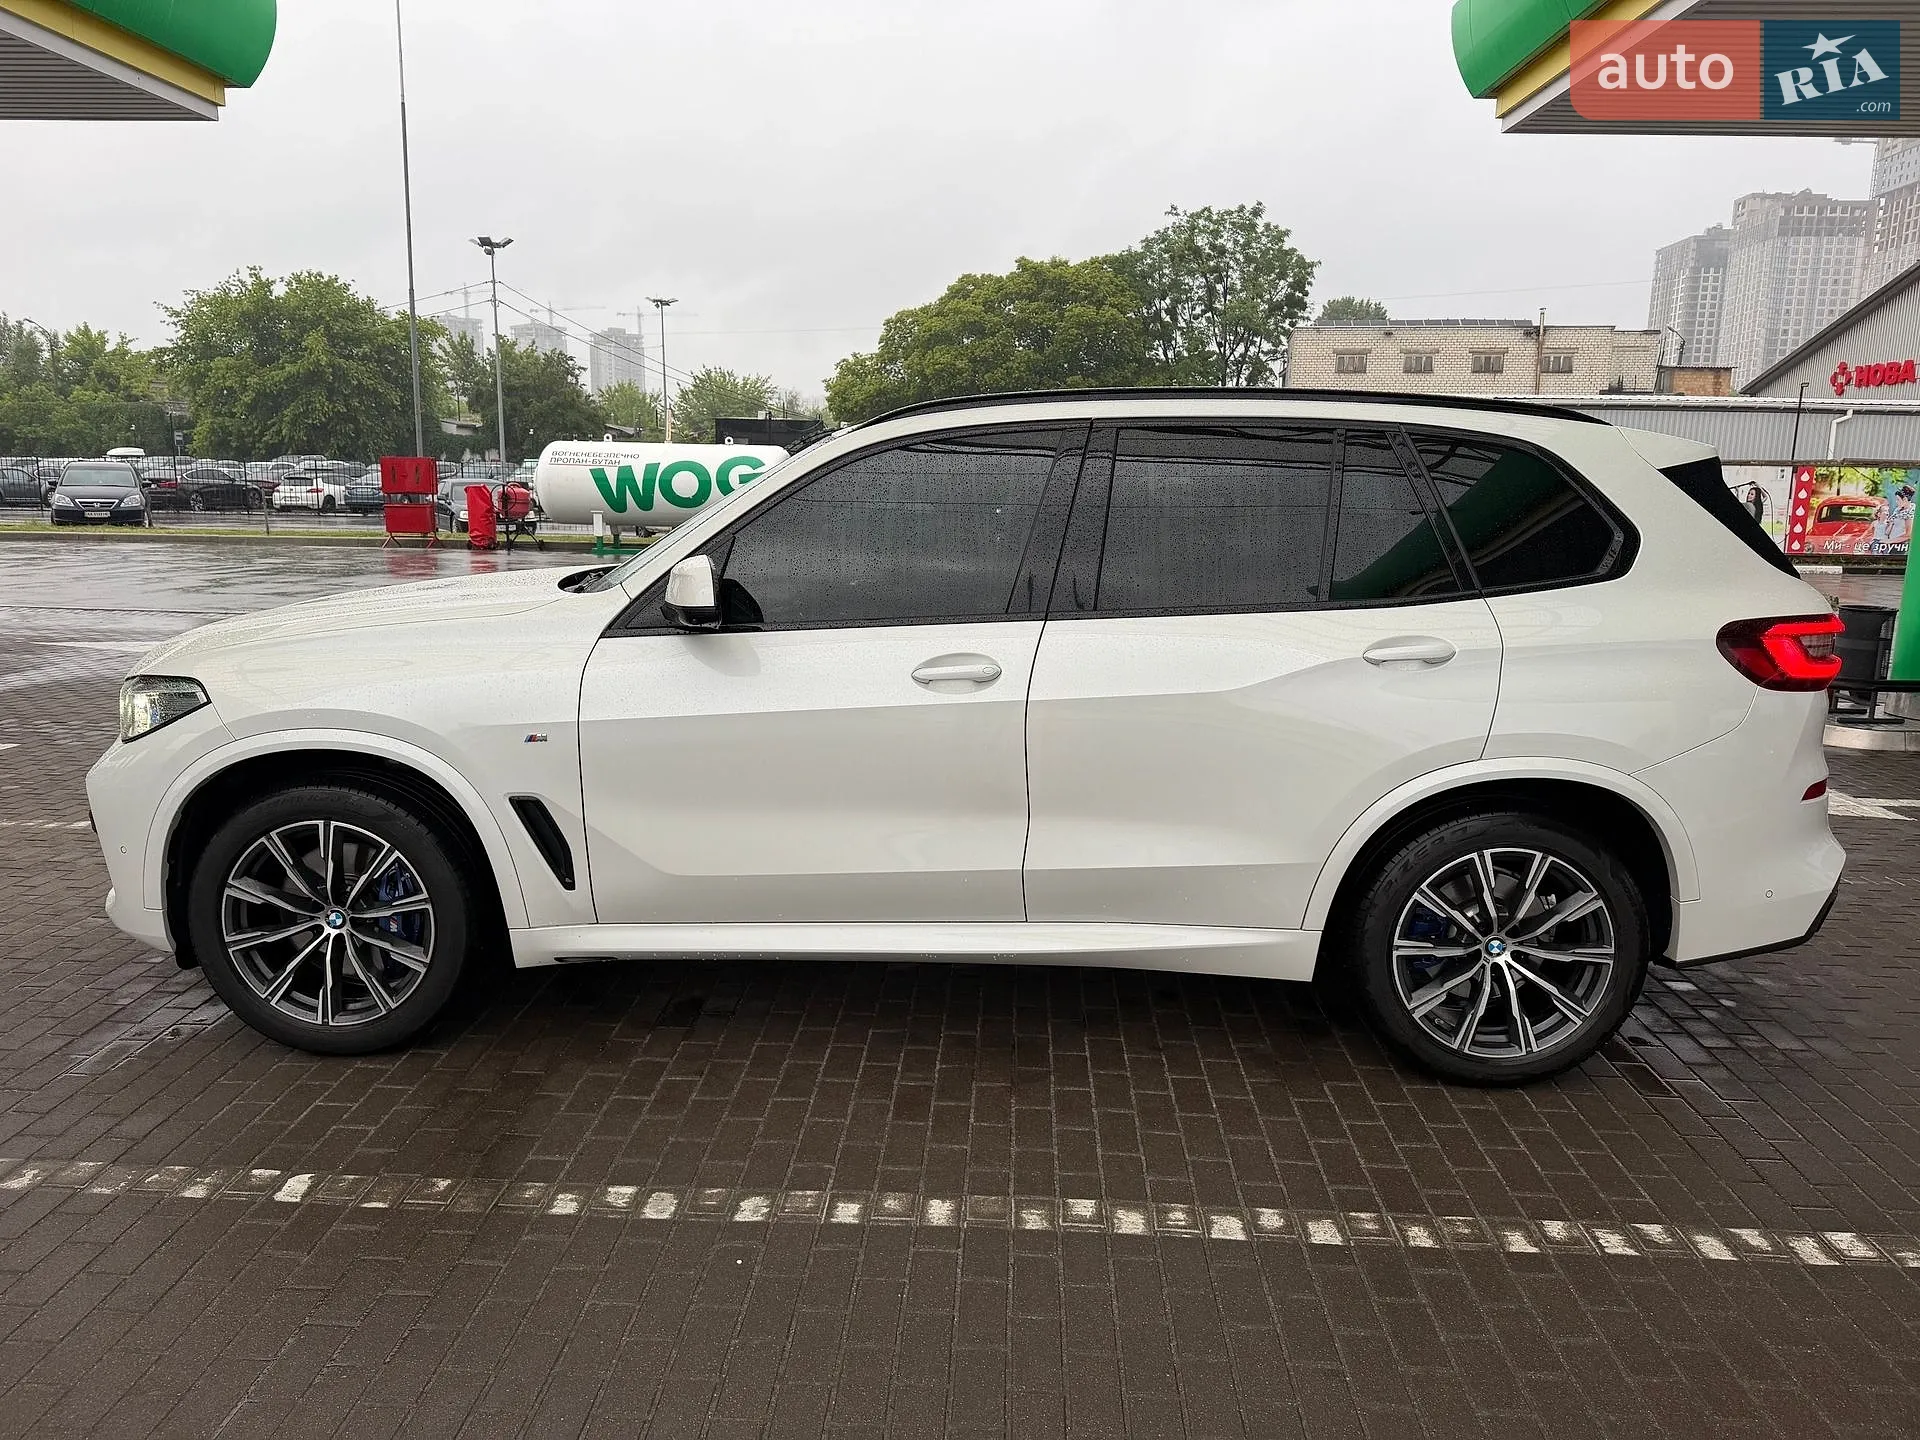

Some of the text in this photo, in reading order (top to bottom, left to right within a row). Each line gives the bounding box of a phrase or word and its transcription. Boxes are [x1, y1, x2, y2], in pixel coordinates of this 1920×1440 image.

[1854, 360, 1916, 388] НОВА
[549, 457, 621, 465] ПРОПАН-БУТАН
[552, 450, 640, 460] ВОГНЕНЕБЕЗПЕЧНО
[589, 456, 766, 513] WOG
[1823, 540, 1842, 550] Ми
[1854, 542, 1870, 552] це
